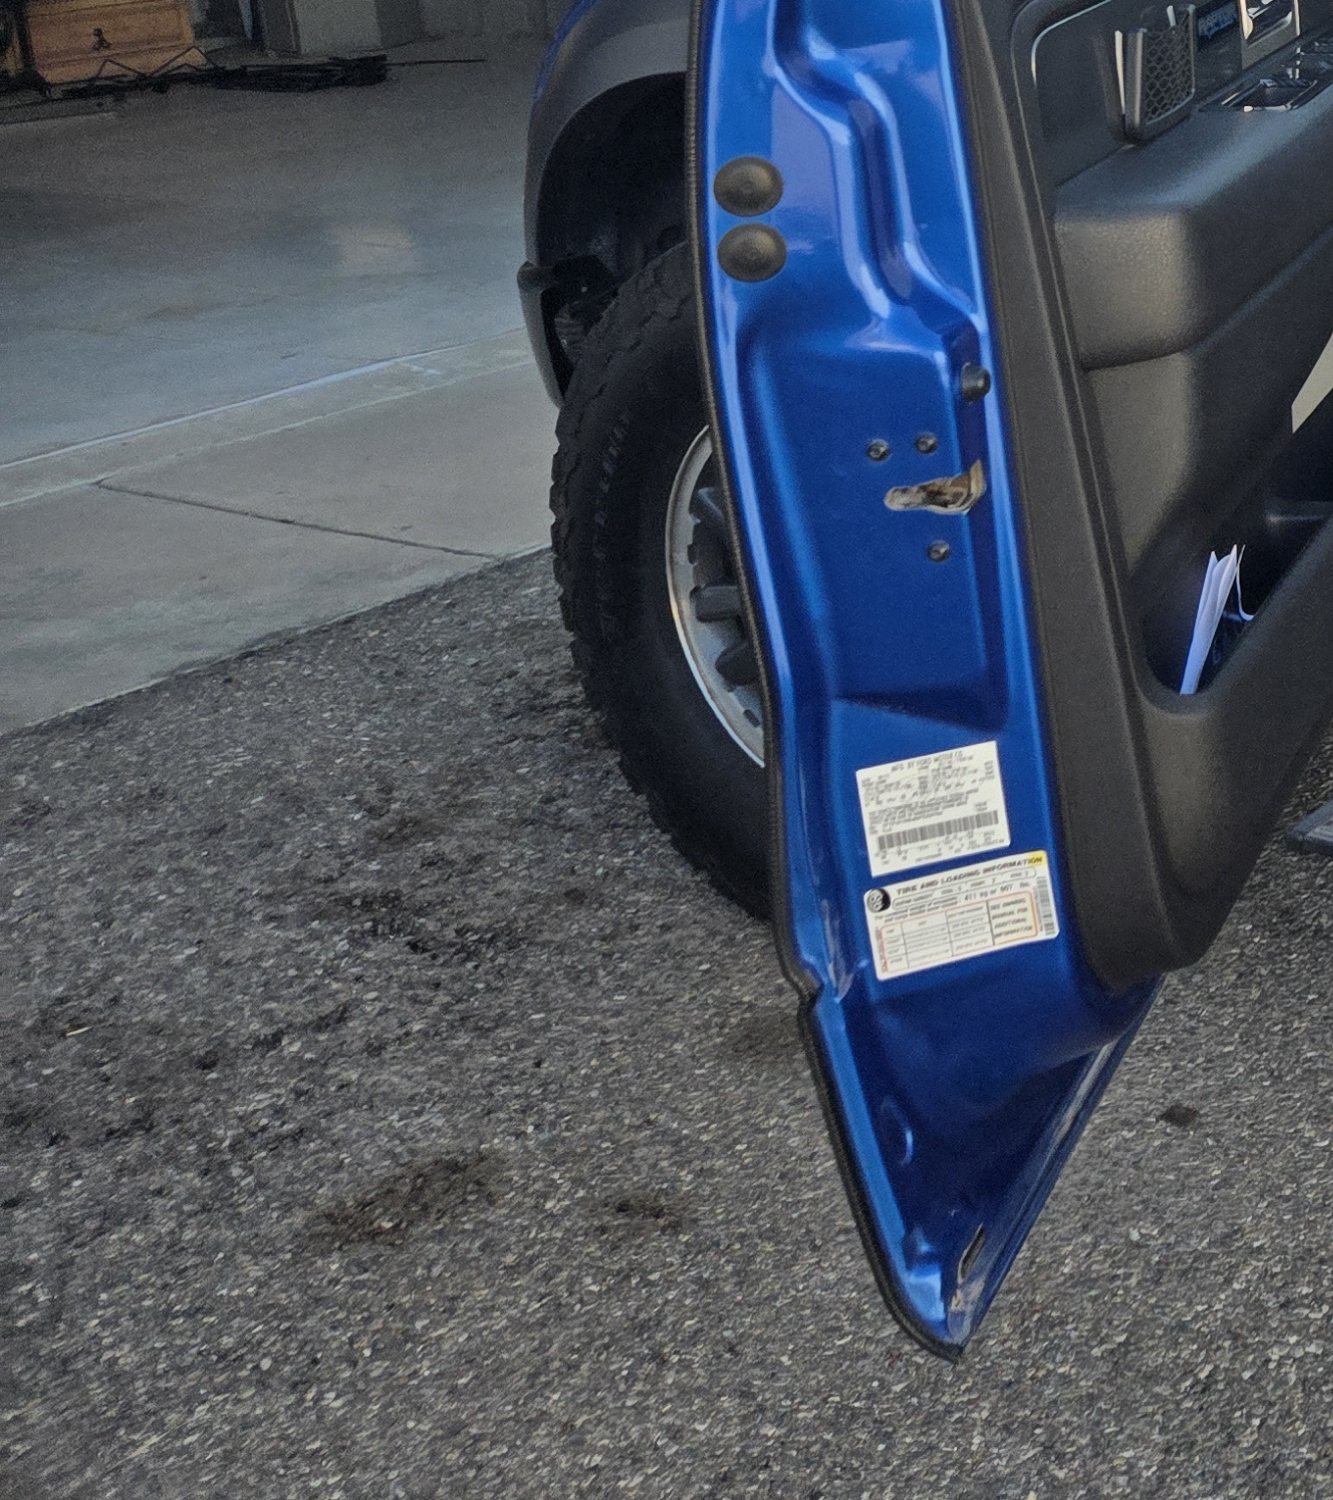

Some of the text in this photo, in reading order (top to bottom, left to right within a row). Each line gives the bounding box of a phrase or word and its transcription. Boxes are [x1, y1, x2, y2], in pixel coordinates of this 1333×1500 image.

[896, 856, 1043, 895] TIRE AND LOADING INFORMATION
